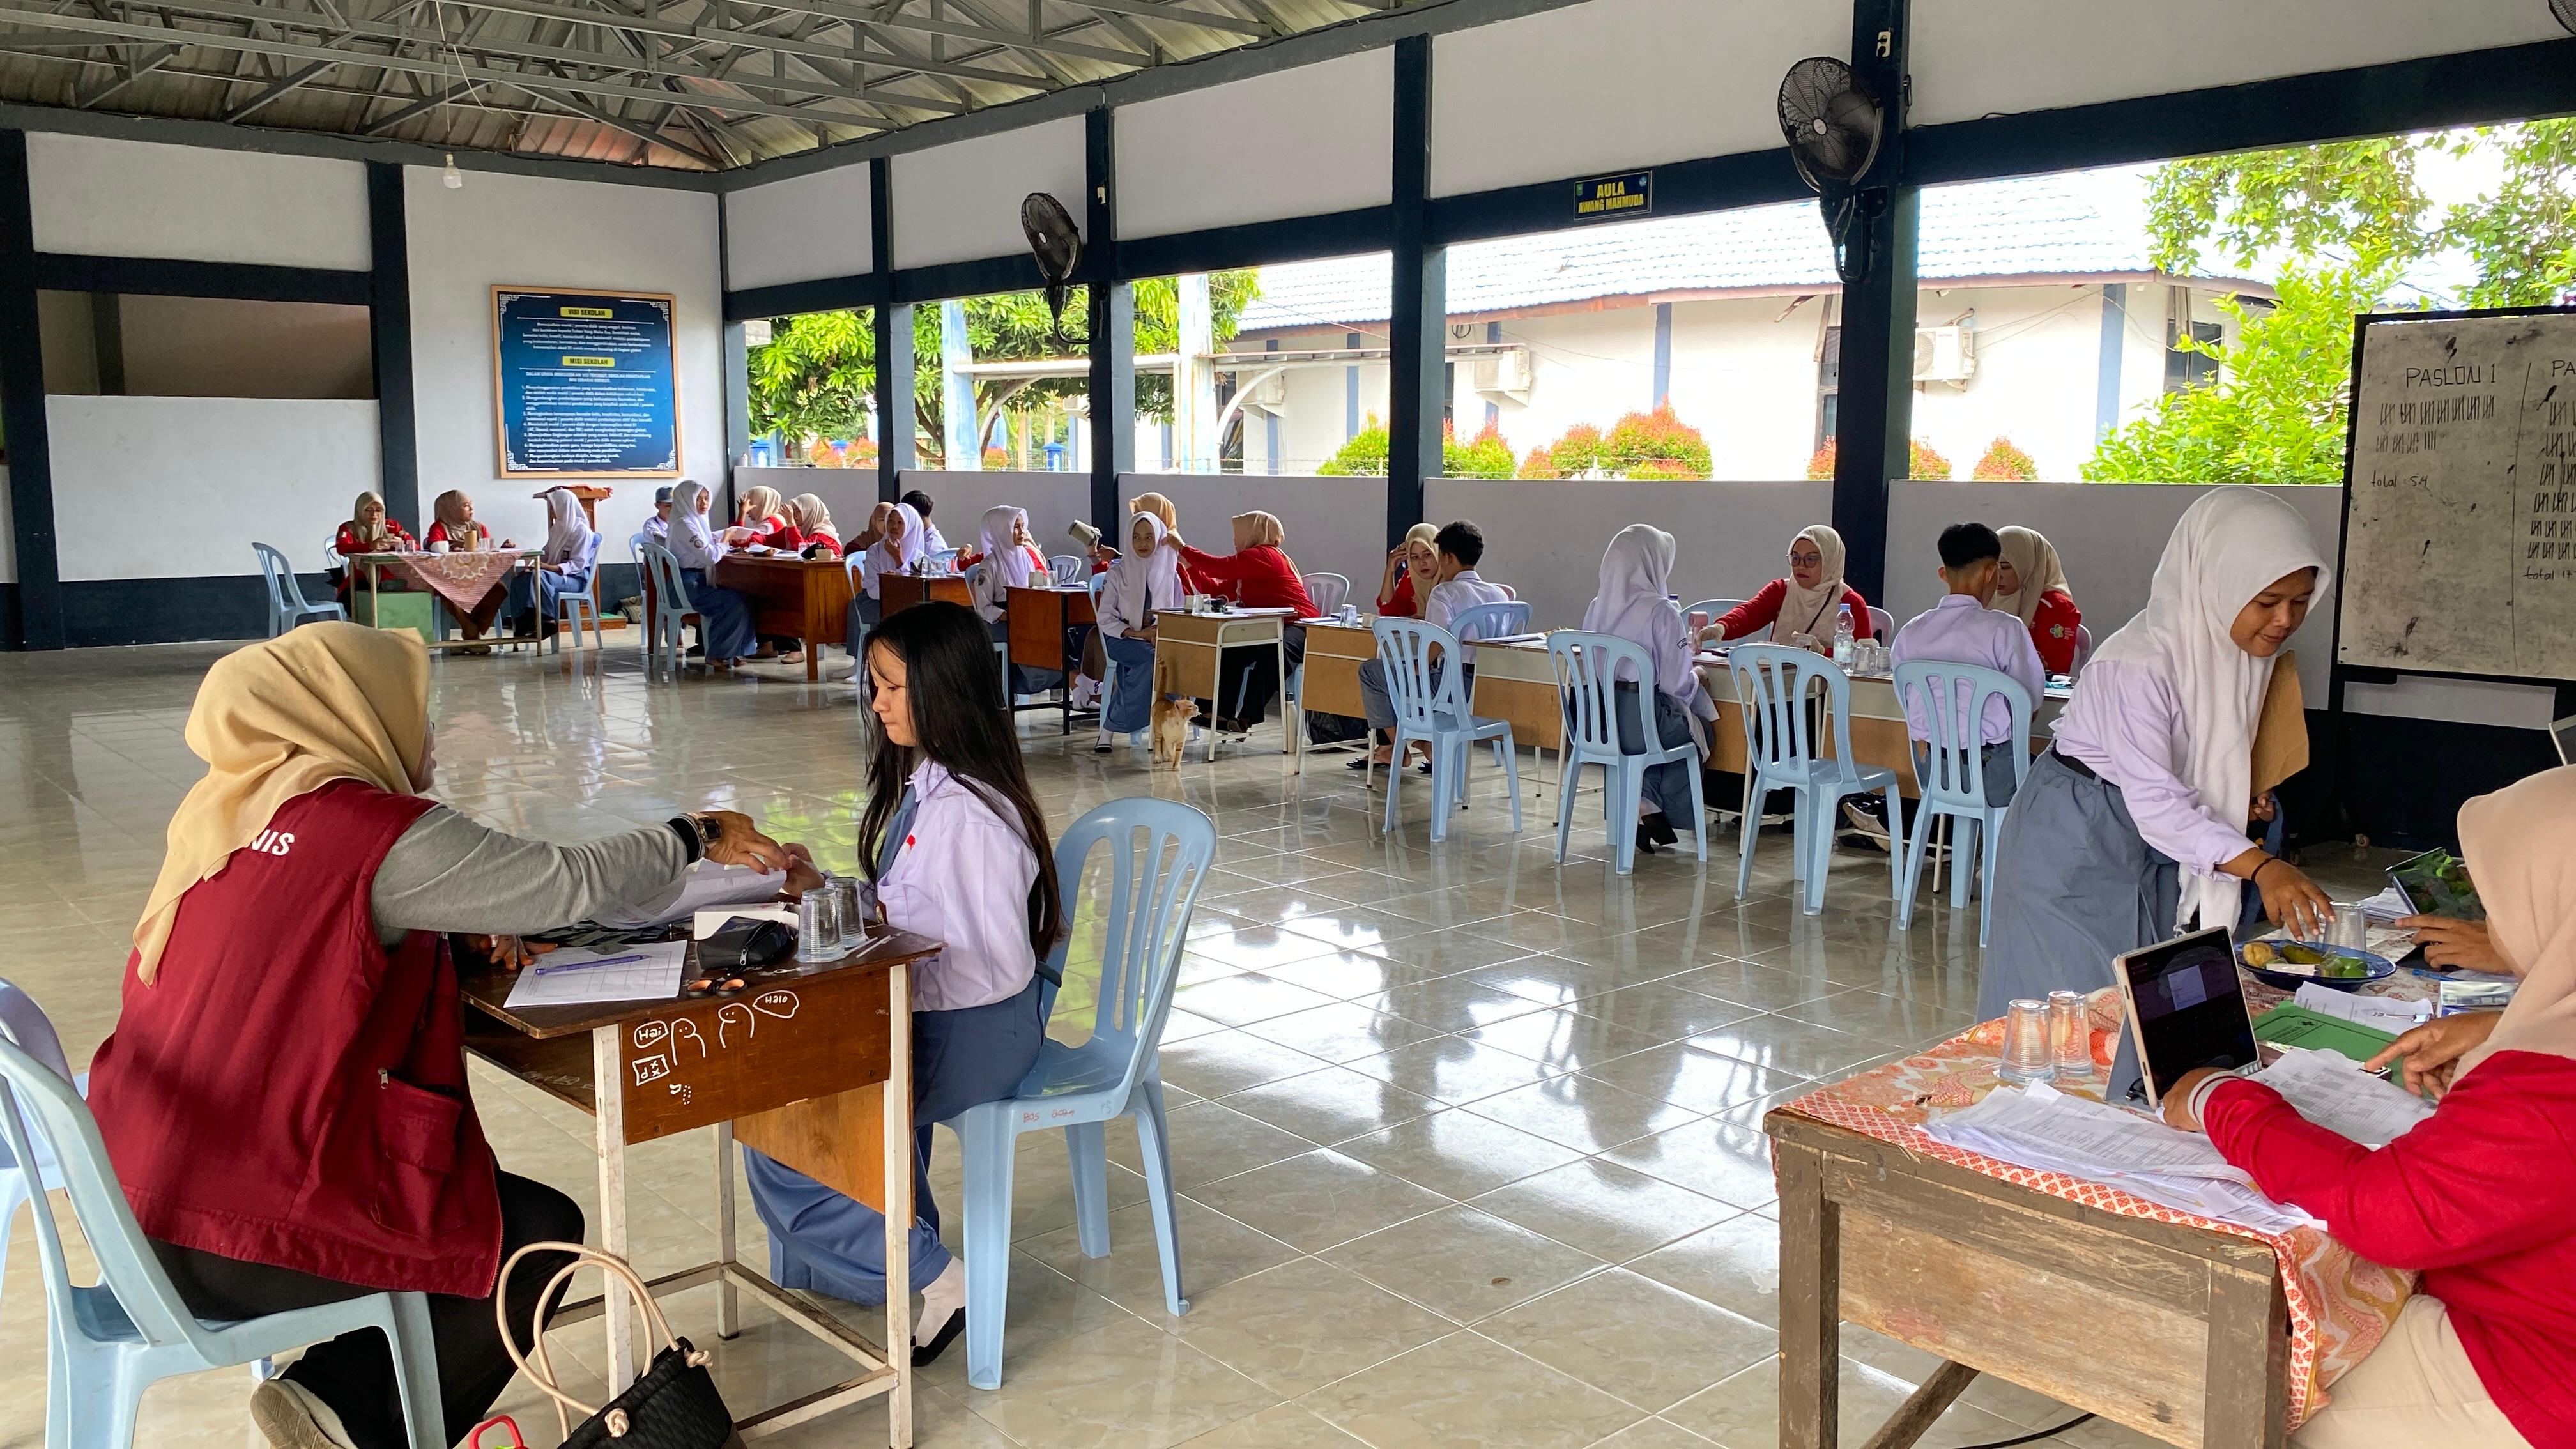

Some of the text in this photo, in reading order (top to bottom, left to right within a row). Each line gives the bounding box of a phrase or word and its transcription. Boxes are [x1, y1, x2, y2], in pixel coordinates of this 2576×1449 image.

[1597, 181, 1625, 198] AULA
[1578, 194, 1644, 213] AWANG MAHMUDA
[2406, 364, 2496, 388] PASLON 1
[2522, 566, 2554, 580] total
[765, 995, 788, 1004] Halo
[638, 1027, 662, 1041] Hai
